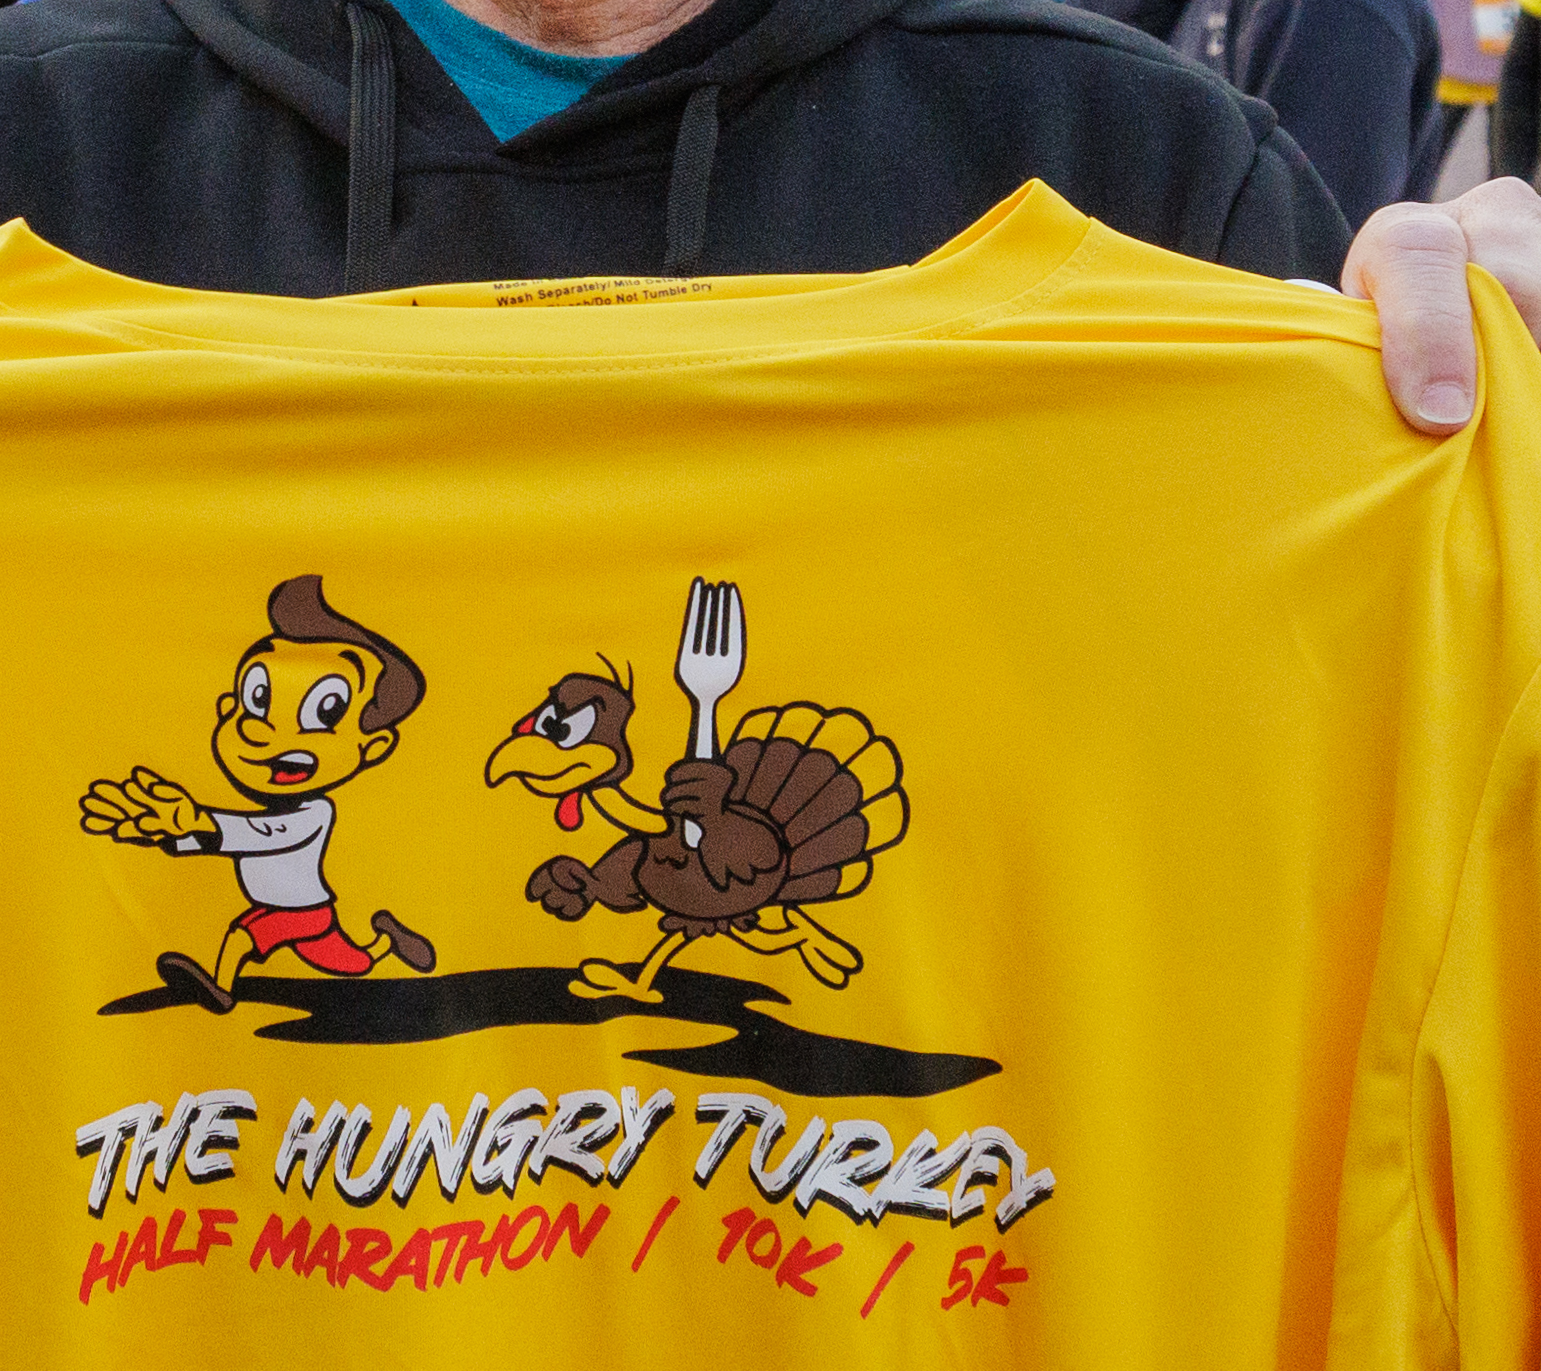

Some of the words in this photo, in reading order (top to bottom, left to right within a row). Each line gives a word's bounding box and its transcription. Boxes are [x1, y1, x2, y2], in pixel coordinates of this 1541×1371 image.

[496, 292, 534, 307] Wash
[616, 293, 638, 304] Not
[642, 285, 688, 300] Tumble
[691, 282, 713, 292] Dry
[76, 1088, 257, 1219] THE
[274, 1086, 676, 1209] HUNGRY
[694, 1092, 1056, 1233] TURKEY
[79, 1208, 239, 1306] HALF
[249, 1202, 611, 1293] MARATHON
[717, 1207, 844, 1298] 10K
[940, 1245, 1029, 1311] 5K
